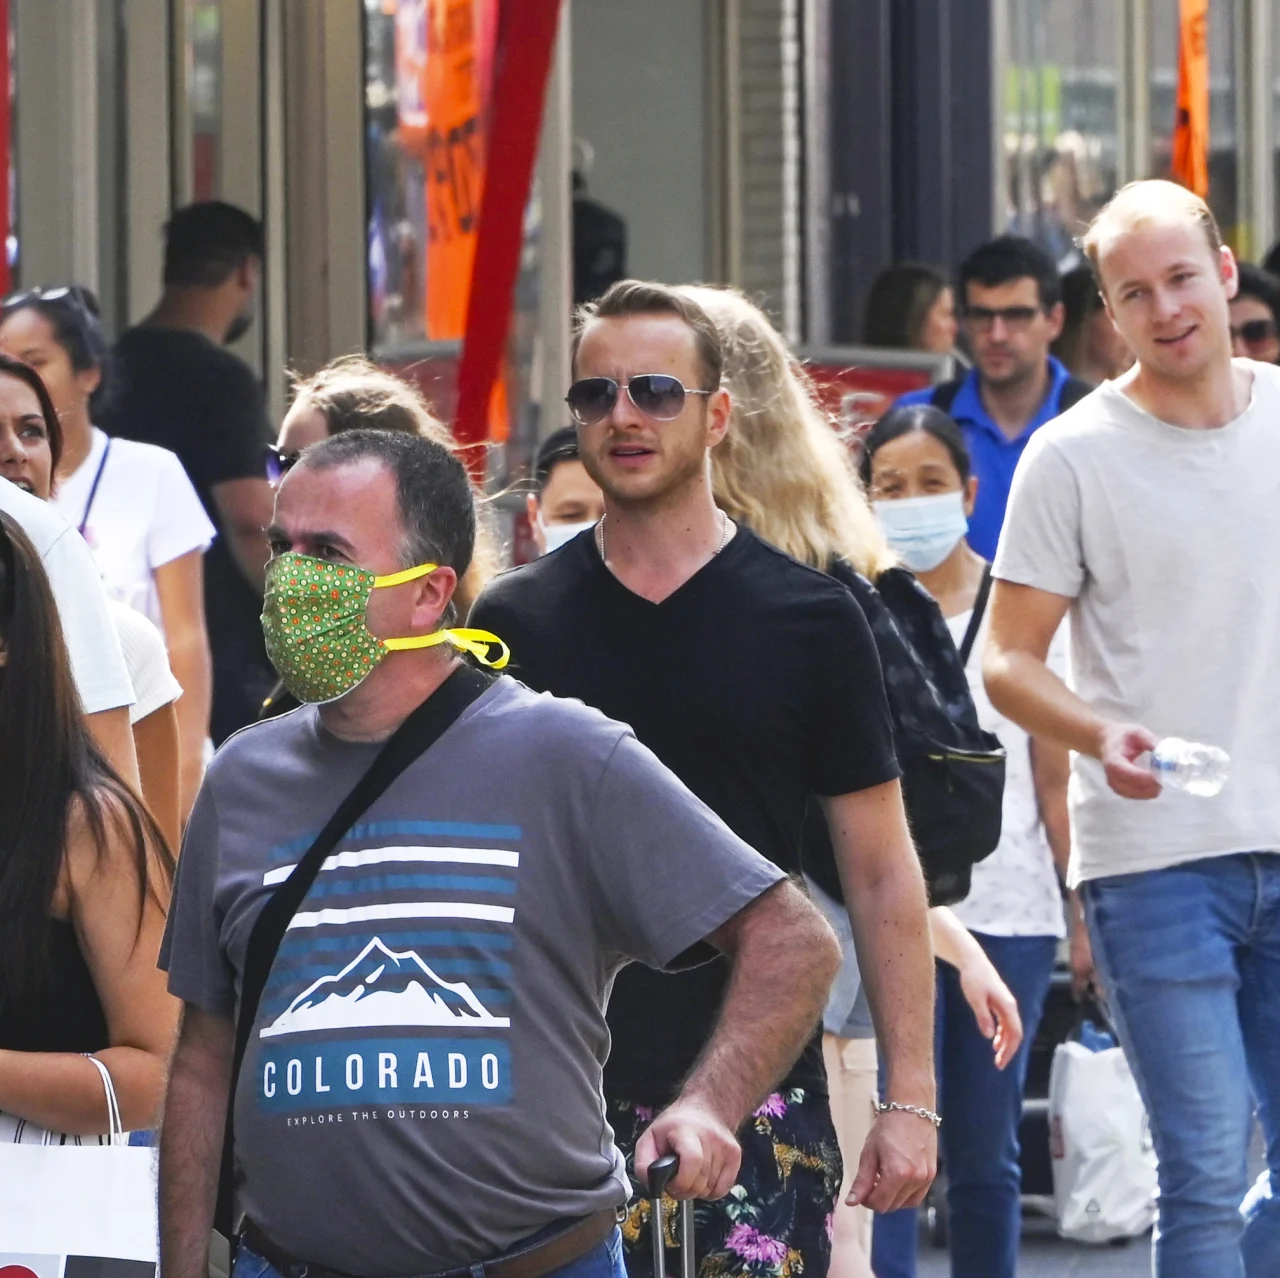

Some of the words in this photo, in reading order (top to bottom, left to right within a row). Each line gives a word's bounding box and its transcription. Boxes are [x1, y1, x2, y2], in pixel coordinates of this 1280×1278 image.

[263, 1051, 499, 1098] COLORADO
[286, 1112, 344, 1127] EXPLORE
[351, 1110, 378, 1121] THE
[387, 1109, 470, 1120] OUTDOORS
